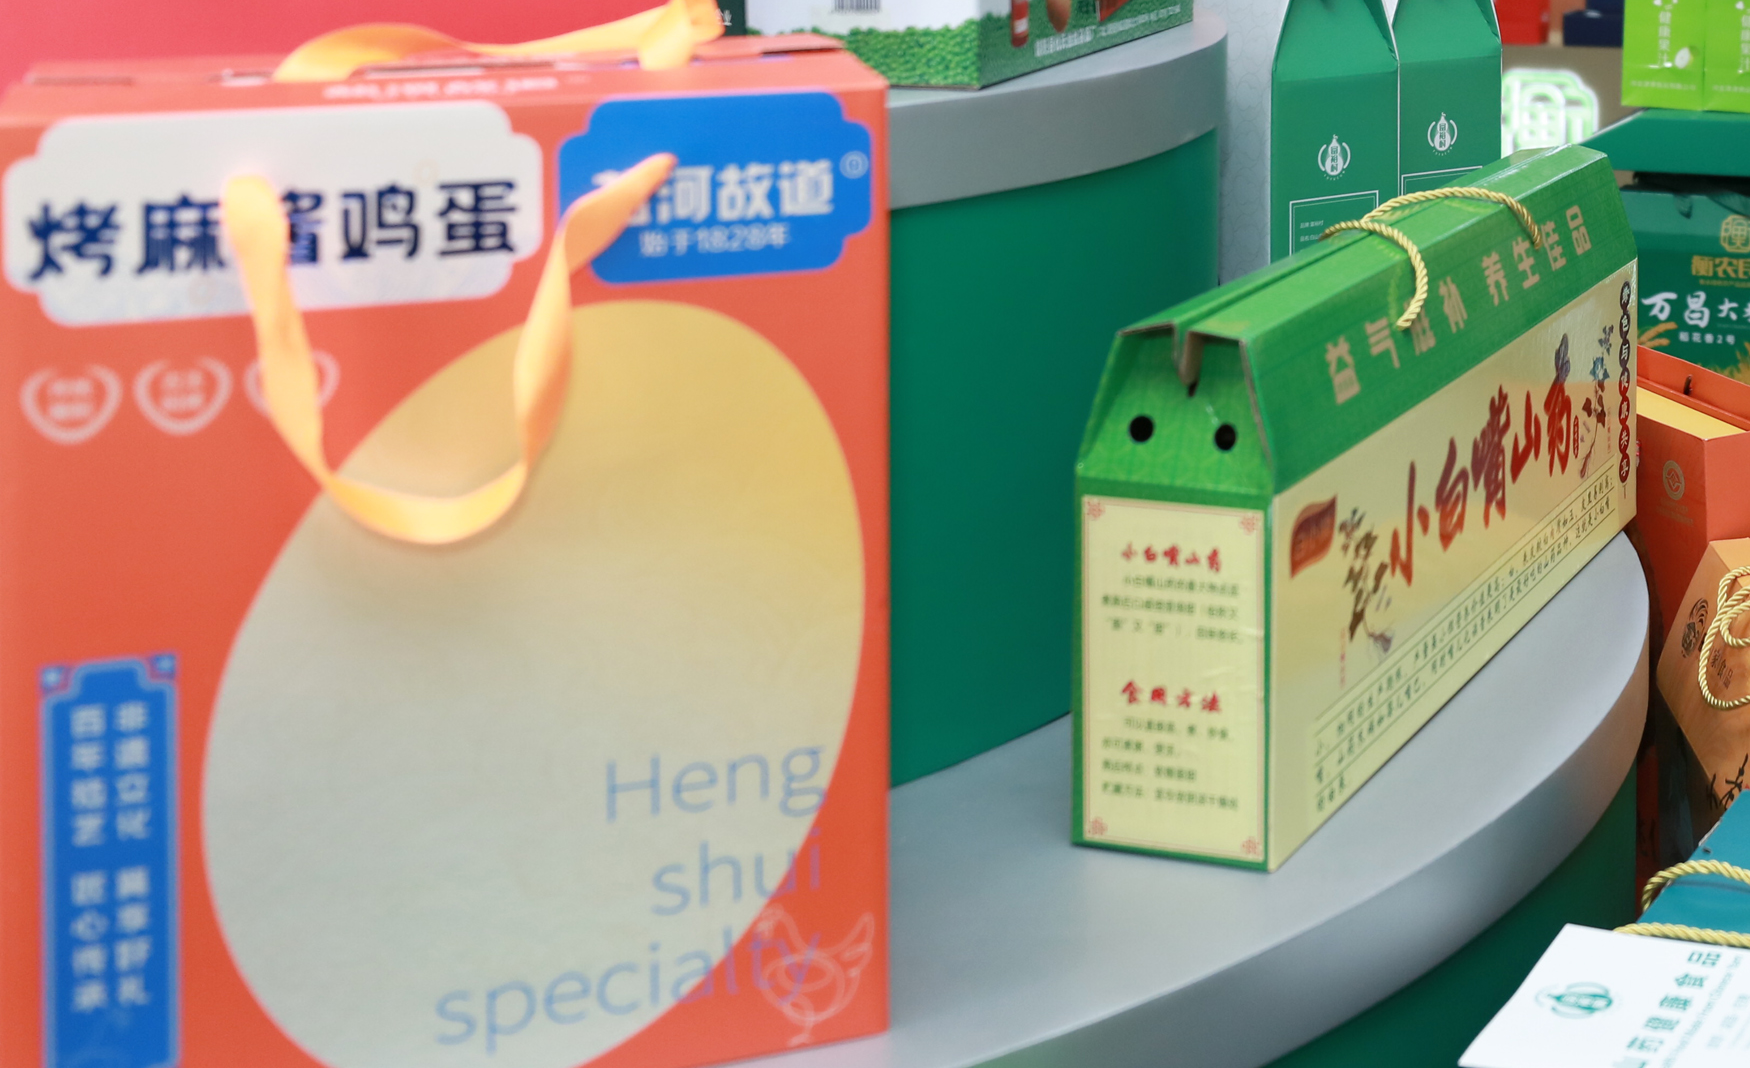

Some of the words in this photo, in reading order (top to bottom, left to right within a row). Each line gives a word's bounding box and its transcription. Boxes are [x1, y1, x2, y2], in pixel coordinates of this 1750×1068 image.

[1121, 680, 1223, 714] 食用方法
[606, 744, 828, 824] Heng
[650, 826, 822, 917] shui
[434, 926, 822, 1057] specialty
